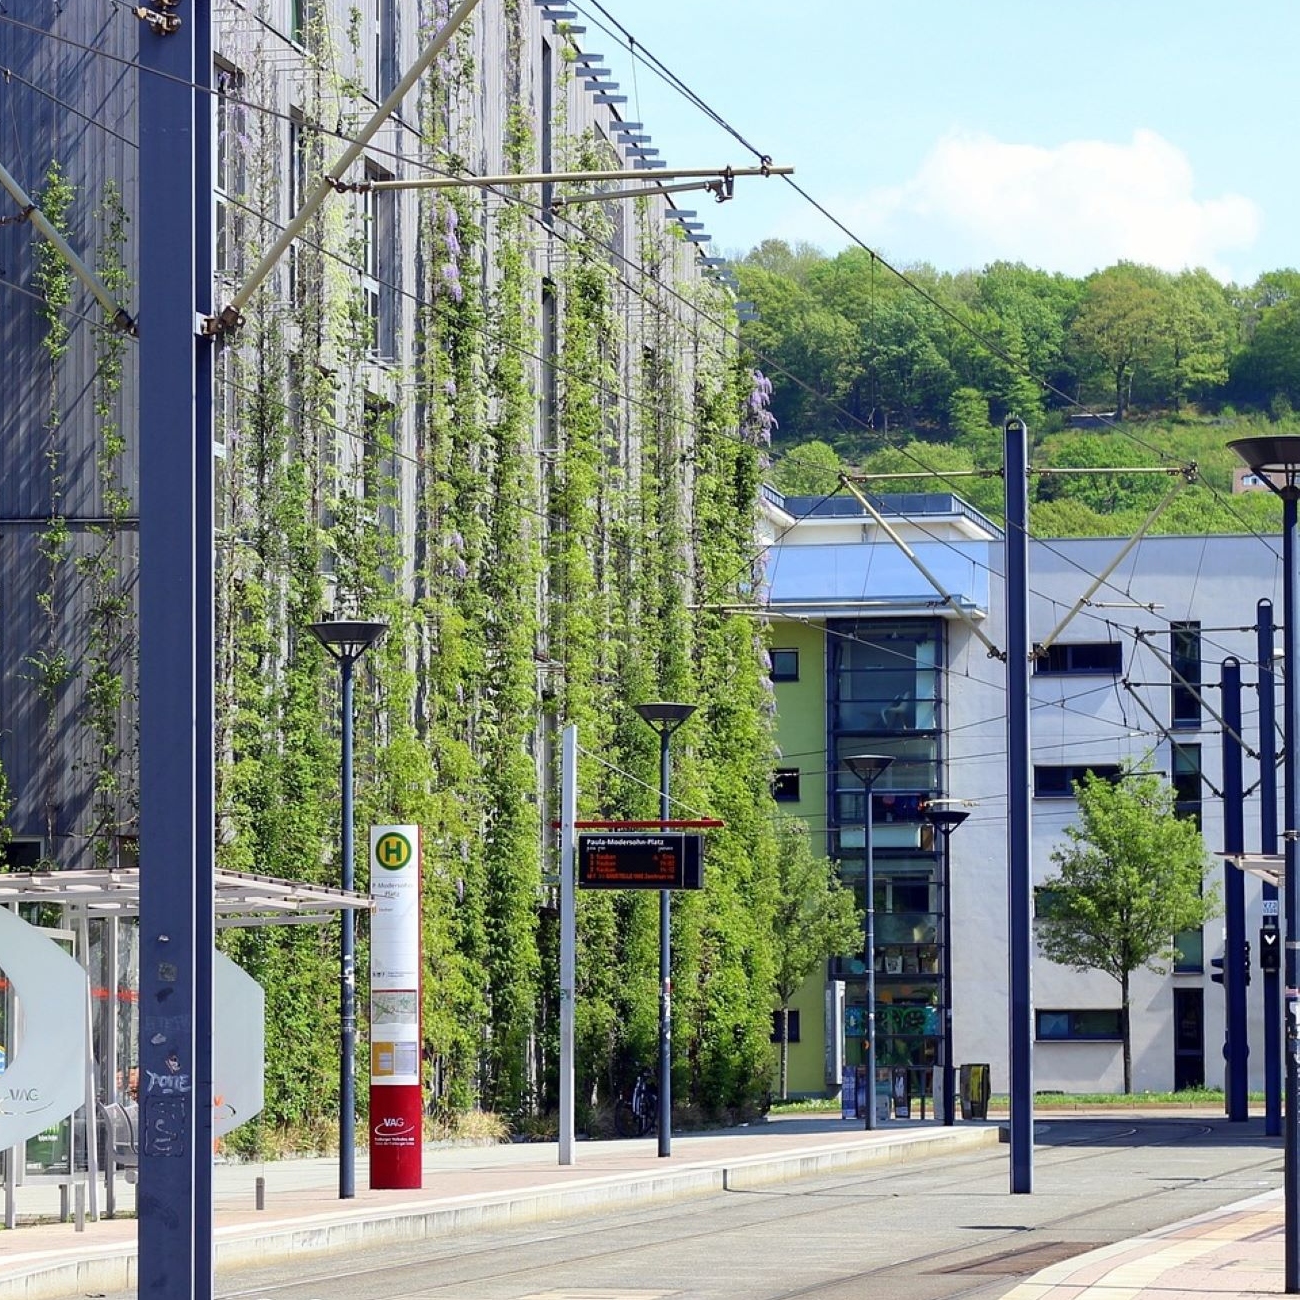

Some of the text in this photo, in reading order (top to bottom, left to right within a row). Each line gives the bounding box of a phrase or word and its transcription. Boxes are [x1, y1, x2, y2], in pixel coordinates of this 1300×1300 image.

[385, 841, 402, 862] H
[9, 1088, 40, 1101] VAG
[383, 1117, 405, 1127] VAG
